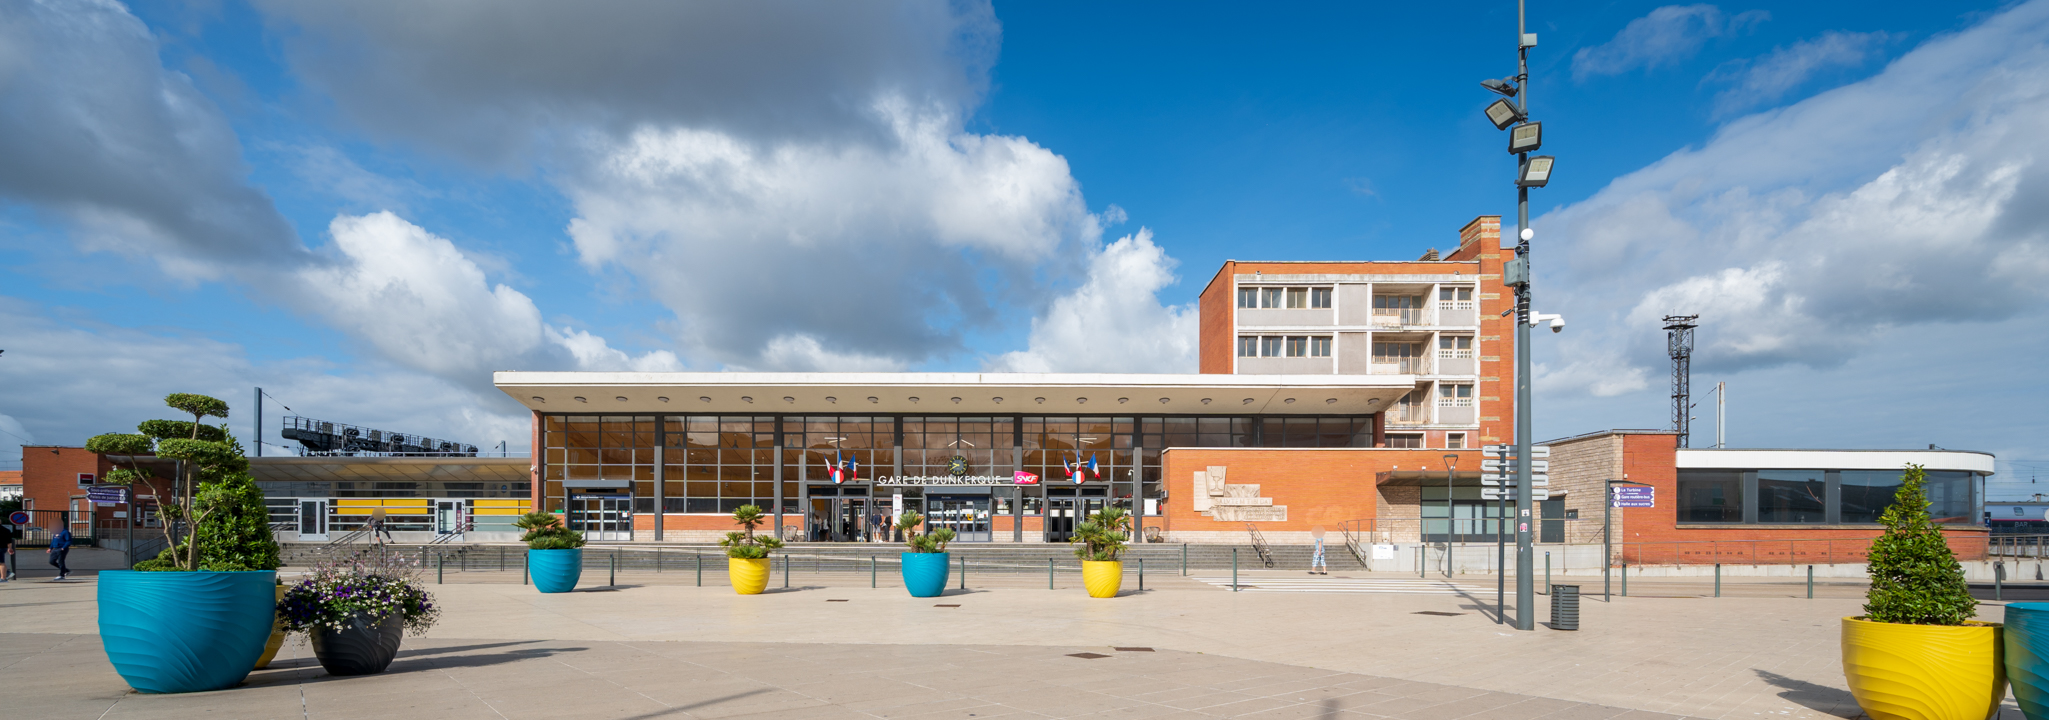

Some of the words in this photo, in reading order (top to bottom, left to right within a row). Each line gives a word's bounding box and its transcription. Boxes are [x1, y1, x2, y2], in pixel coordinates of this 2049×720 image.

[878, 475, 908, 484] GARE
[913, 475, 927, 484] DE
[932, 475, 1001, 484] DUNKERQUE
